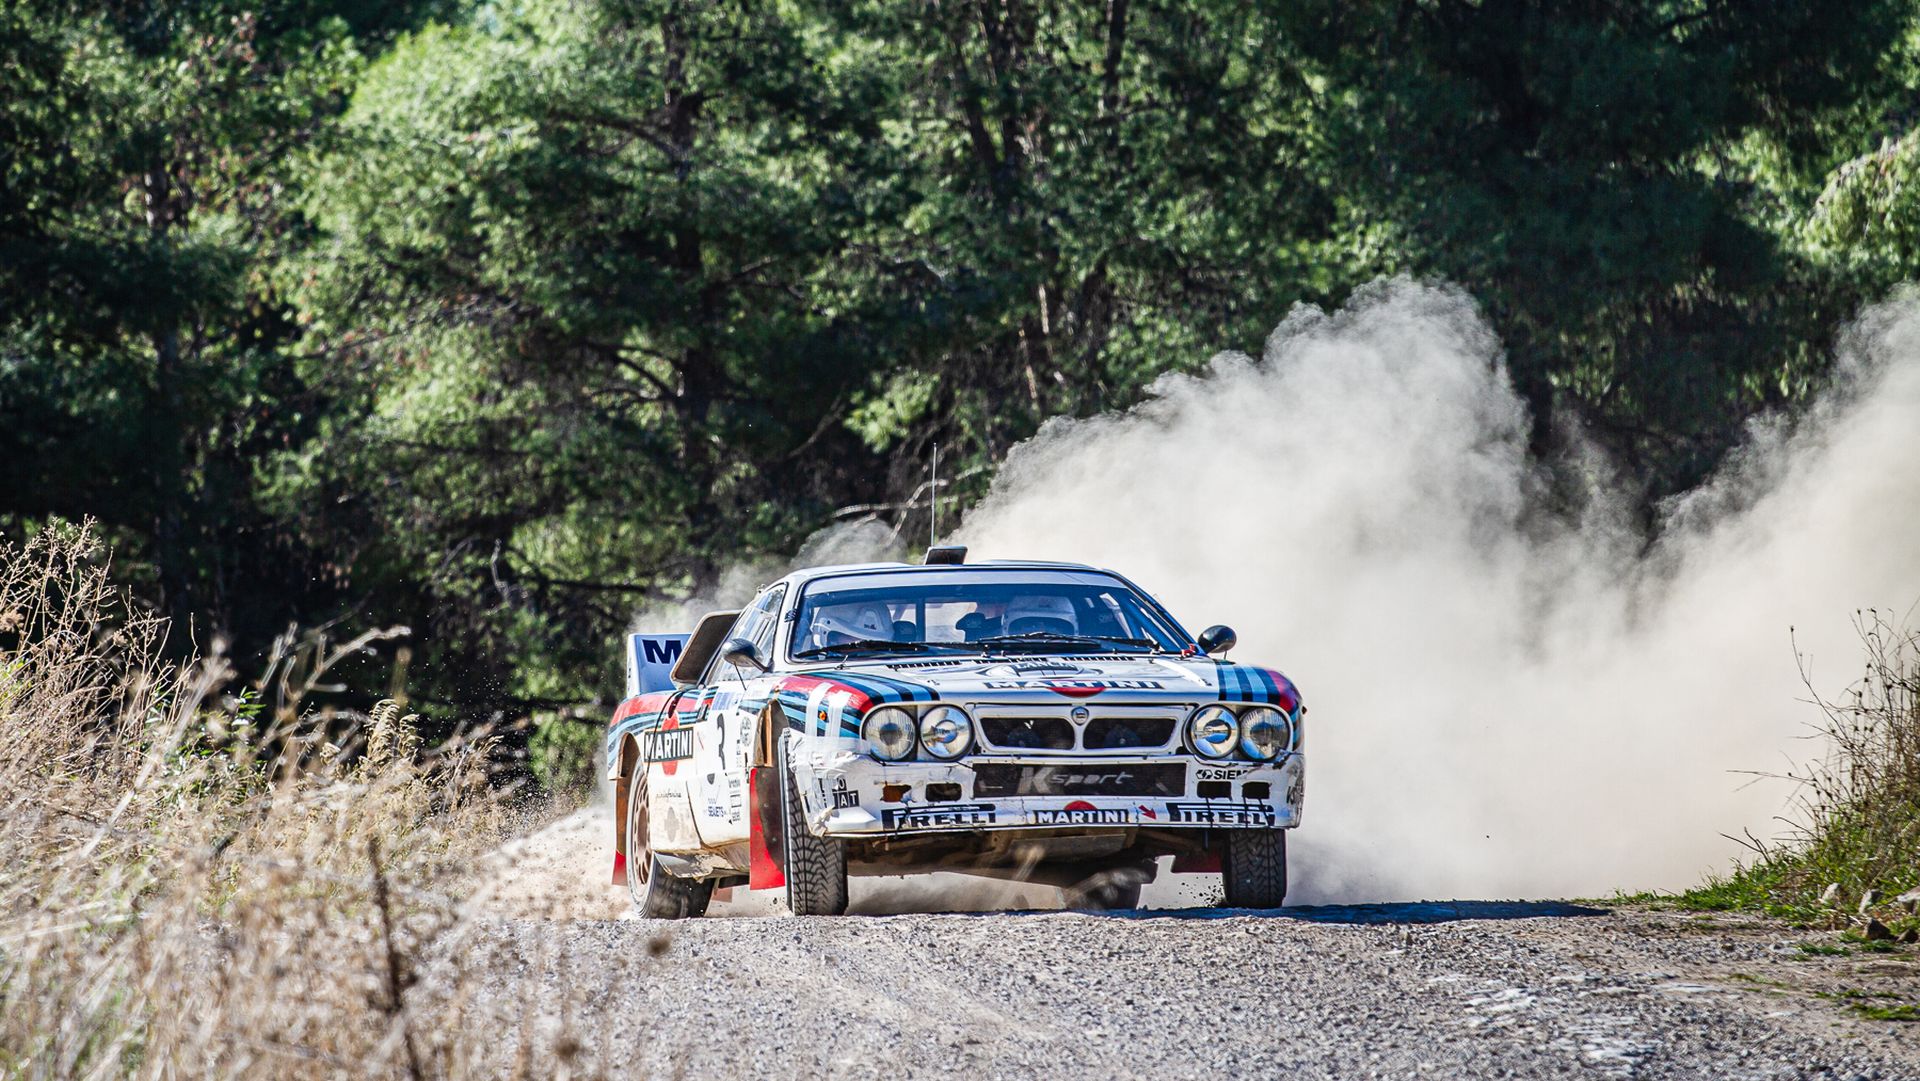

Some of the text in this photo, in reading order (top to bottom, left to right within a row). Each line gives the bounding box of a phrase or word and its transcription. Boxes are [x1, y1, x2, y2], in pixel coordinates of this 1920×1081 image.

[986, 680, 1157, 689] MARTINI
[644, 730, 693, 761] MARTINI
[1037, 809, 1126, 824] MARTINI
[1166, 803, 1276, 826] PIRELLI
